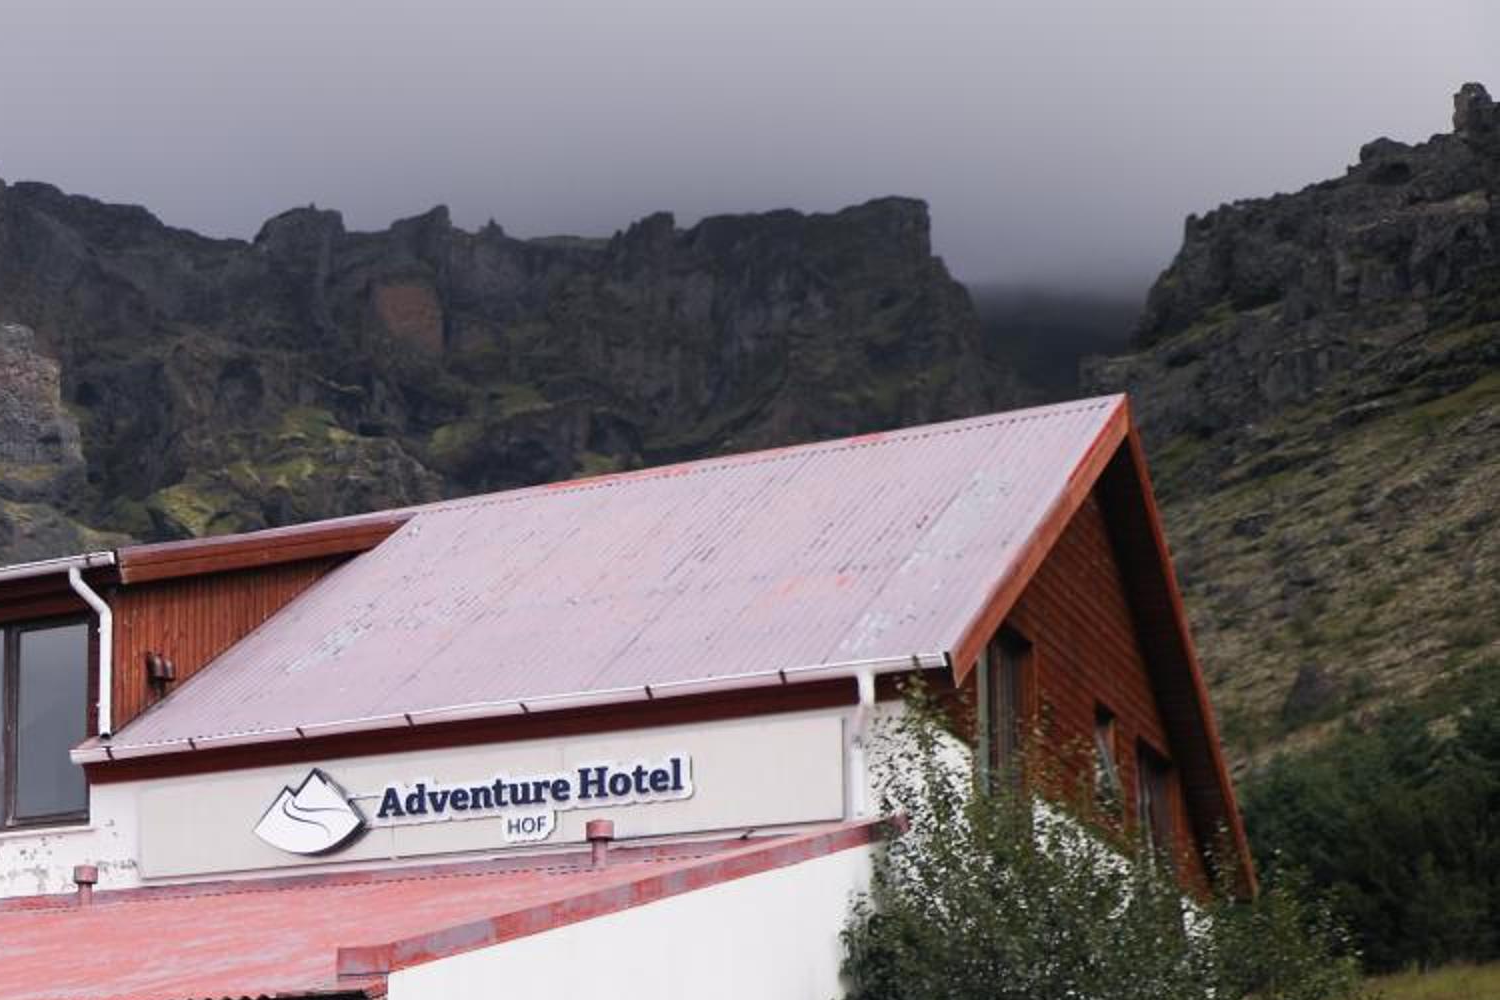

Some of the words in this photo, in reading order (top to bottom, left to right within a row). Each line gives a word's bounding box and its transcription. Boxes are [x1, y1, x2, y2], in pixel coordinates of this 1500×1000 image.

[377, 777, 570, 818] Adventure
[577, 757, 684, 798] Hotel
[507, 815, 548, 835] HOF
